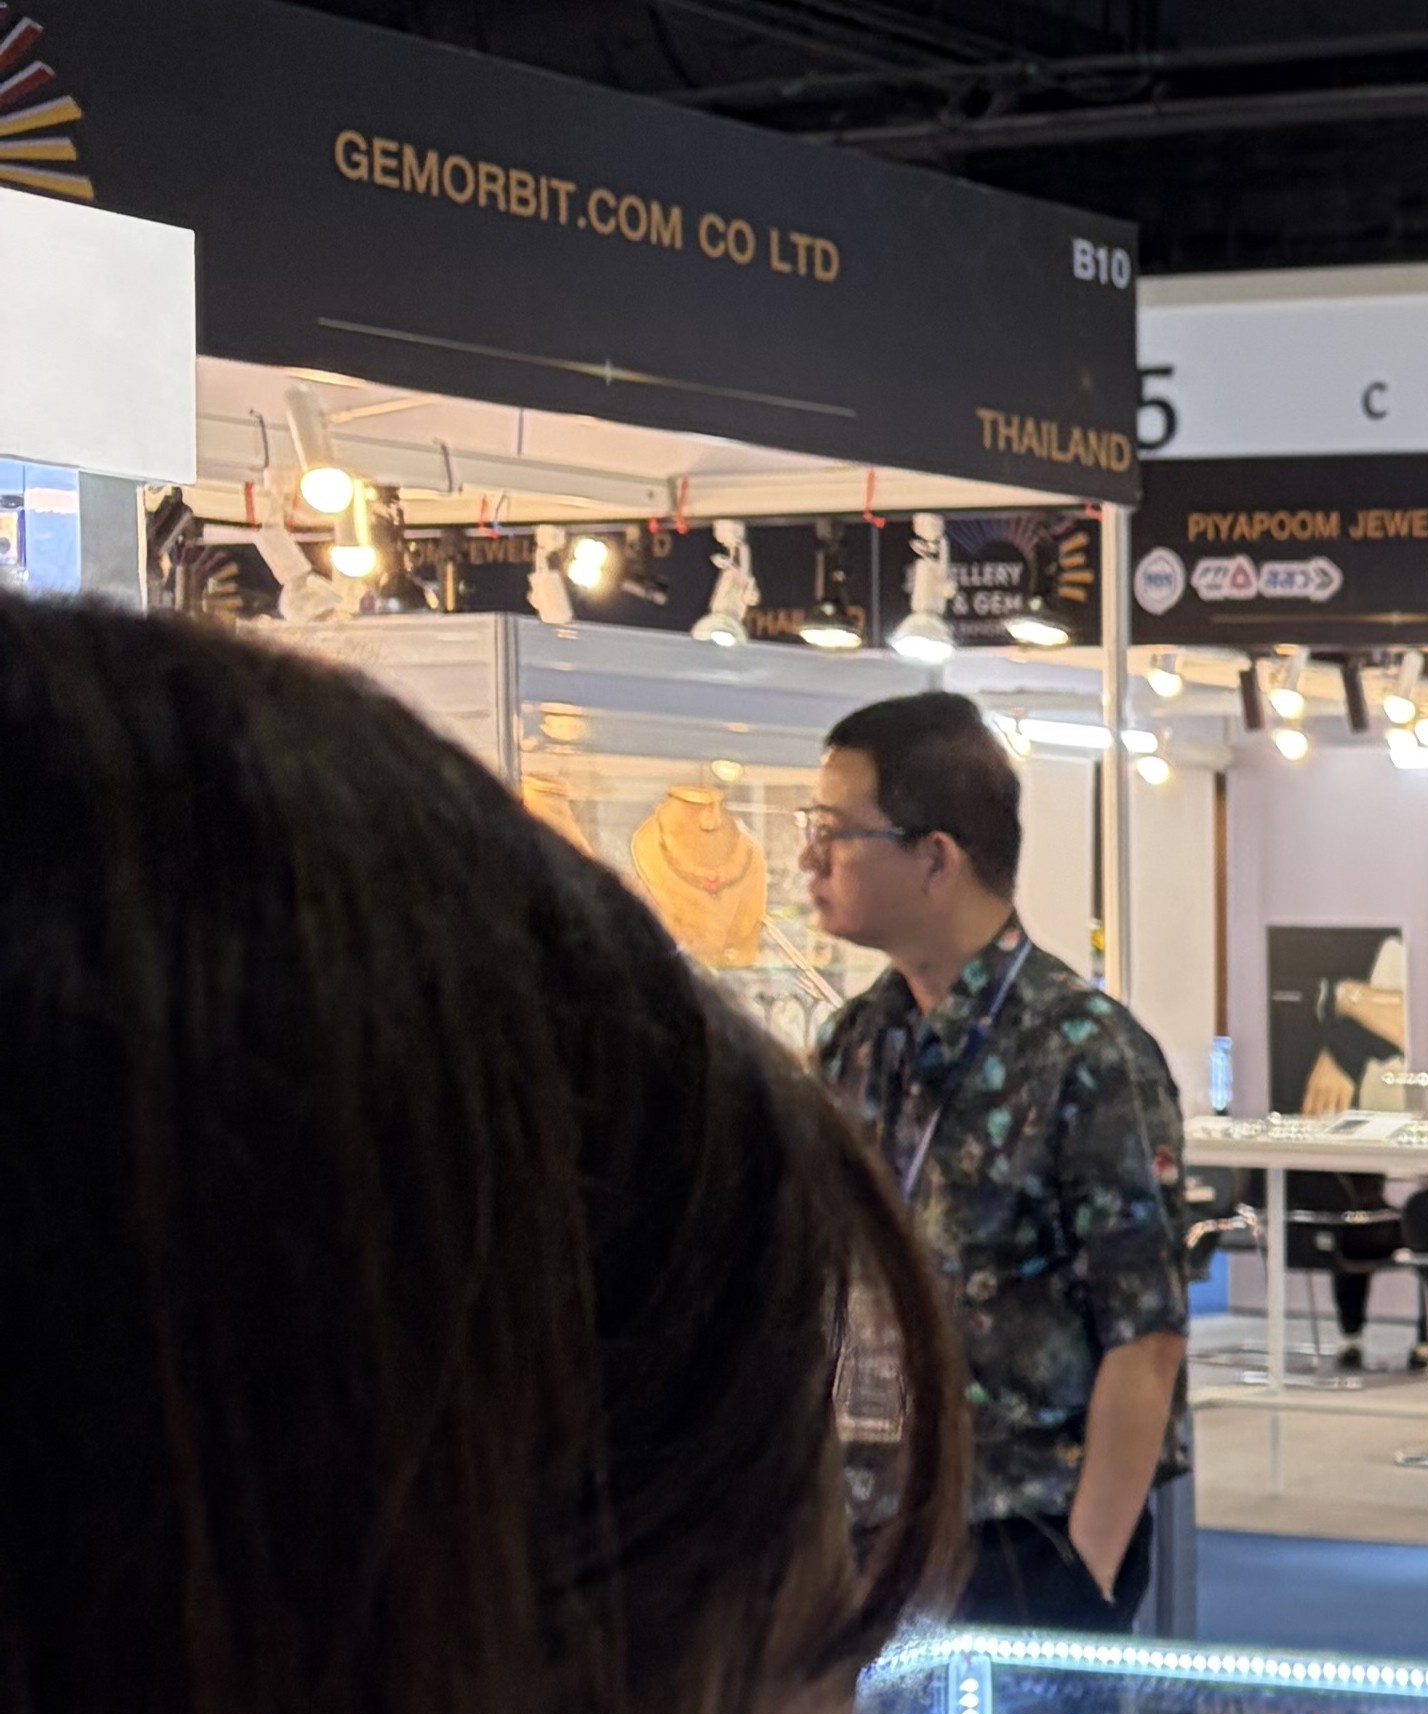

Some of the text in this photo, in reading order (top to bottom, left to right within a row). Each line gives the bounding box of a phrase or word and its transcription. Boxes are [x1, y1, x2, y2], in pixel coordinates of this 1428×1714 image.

[335, 129, 840, 283] GEMORBIT.COM CO LTD
[1073, 238, 1131, 289] B10
[1361, 380, 1388, 421] C
[976, 406, 1132, 473] THAILAND
[1187, 511, 1340, 542] PIYAPOOM
